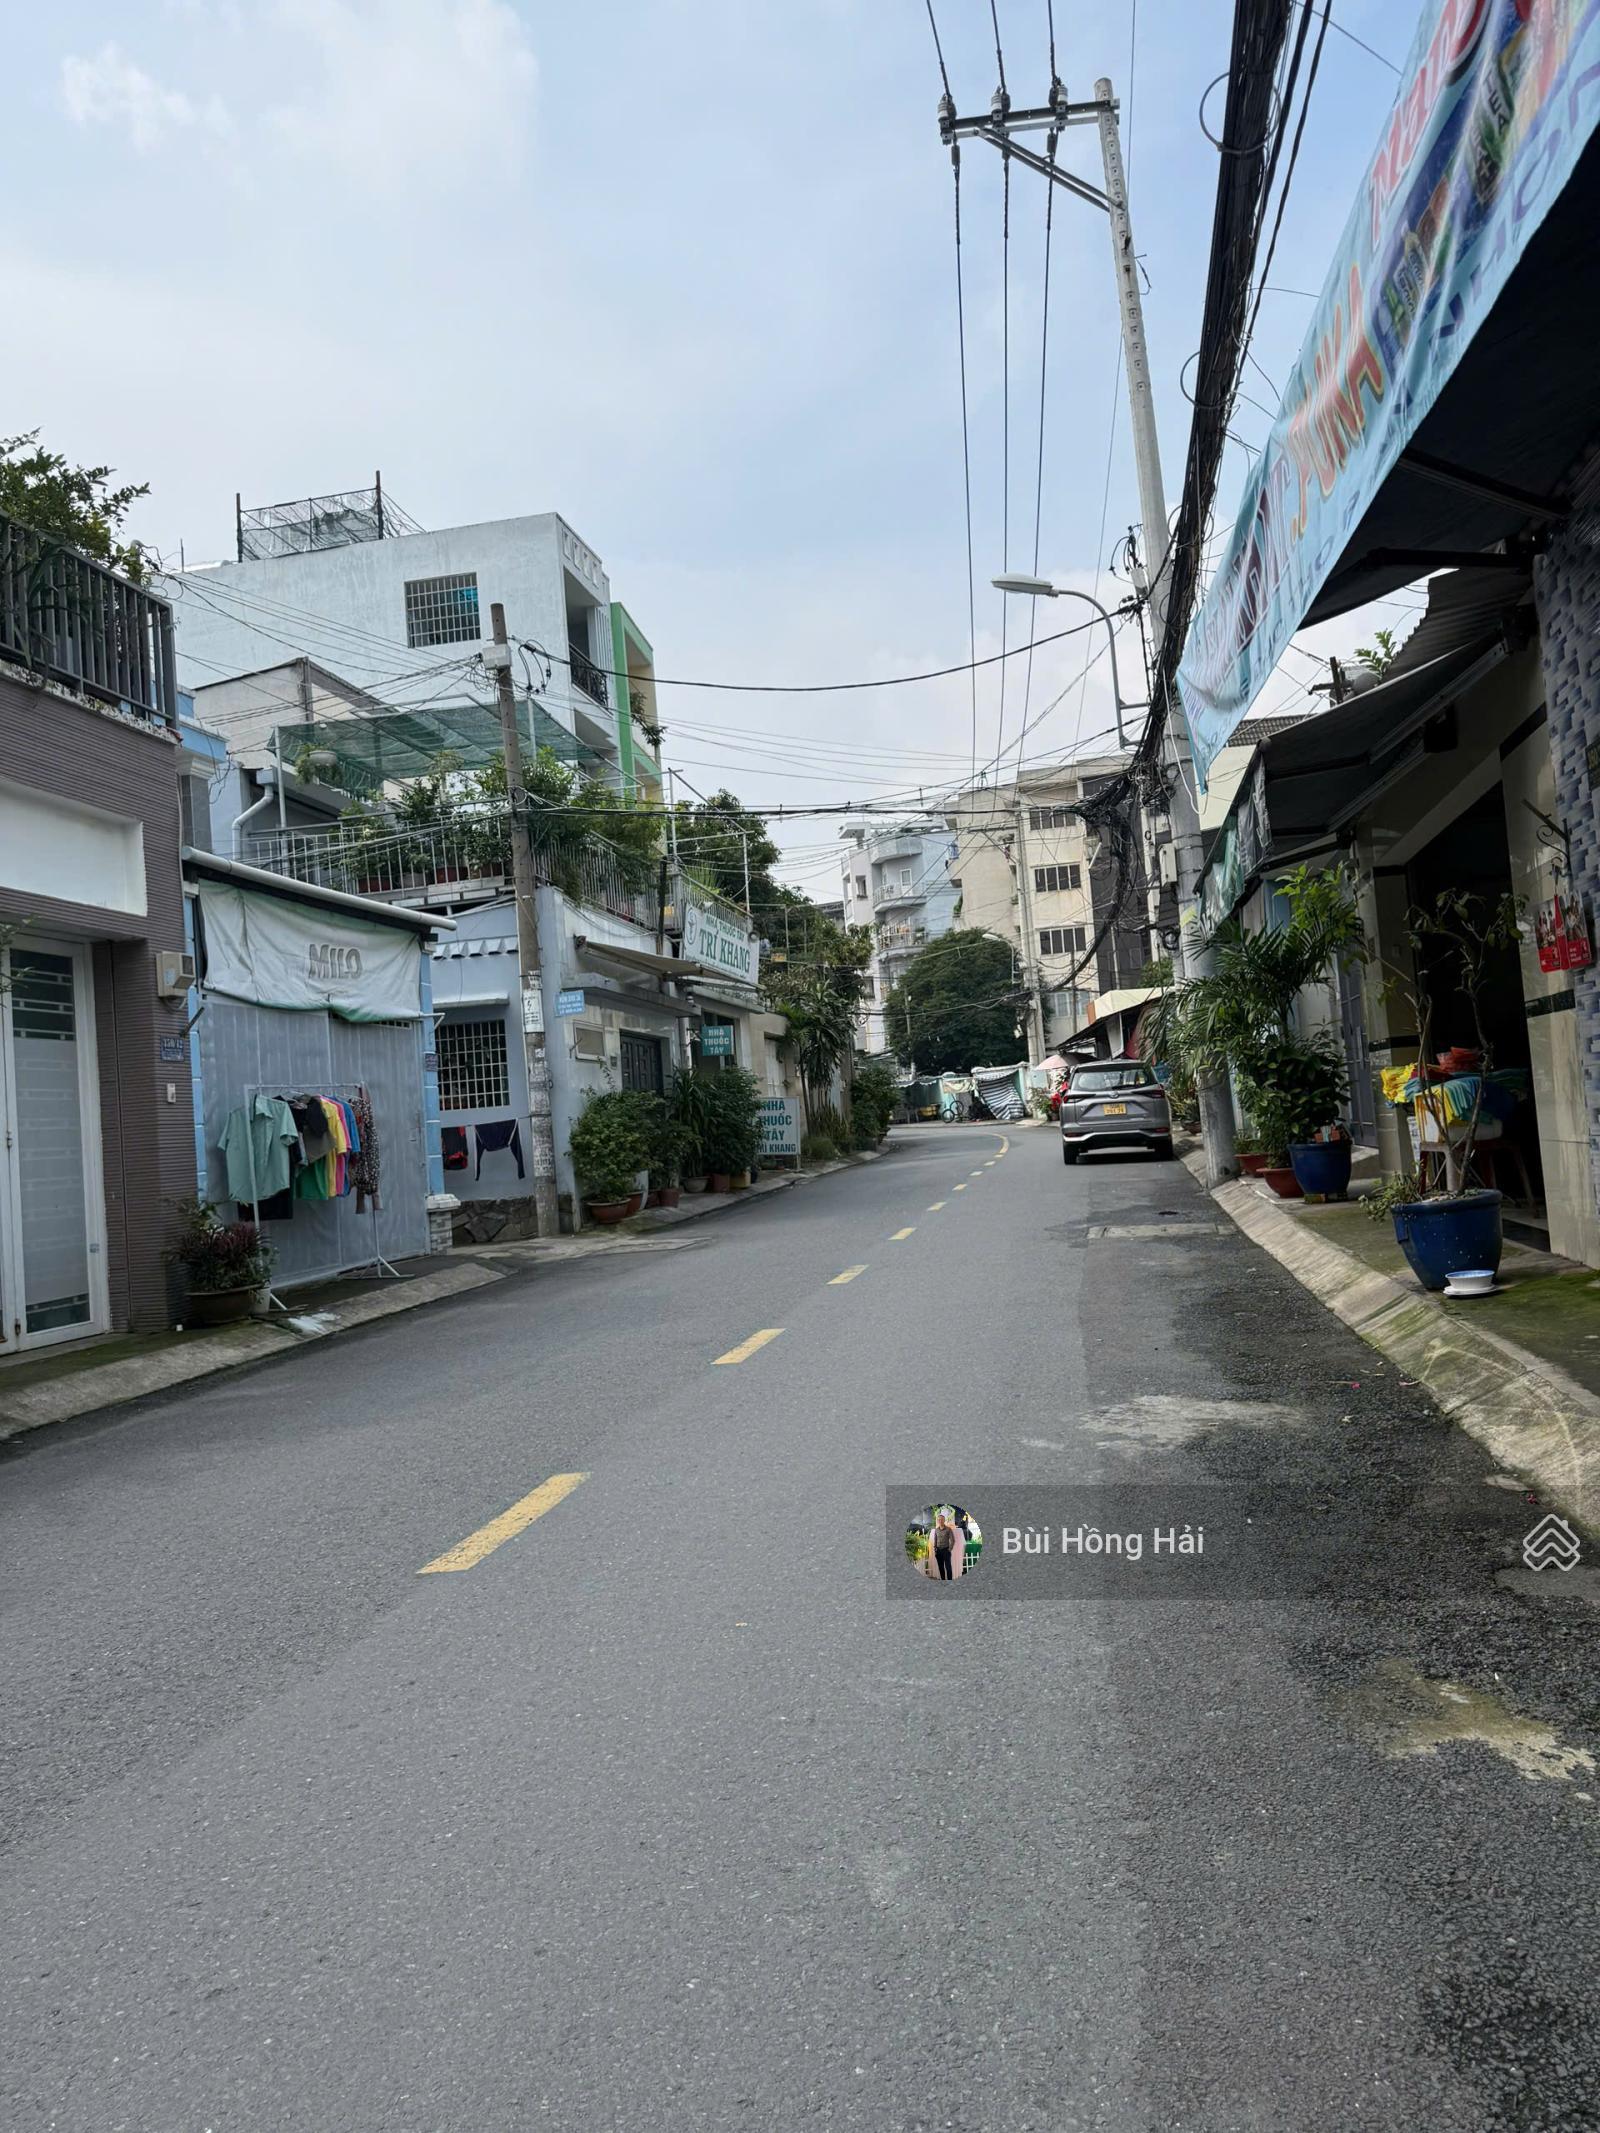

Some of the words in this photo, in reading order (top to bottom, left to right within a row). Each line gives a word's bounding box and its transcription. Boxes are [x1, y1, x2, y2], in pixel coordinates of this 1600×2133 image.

[308, 943, 363, 979] MILO
[699, 928, 719, 961] TRÍ
[719, 937, 751, 974] KHANG
[769, 1143, 797, 1153] KHANG
